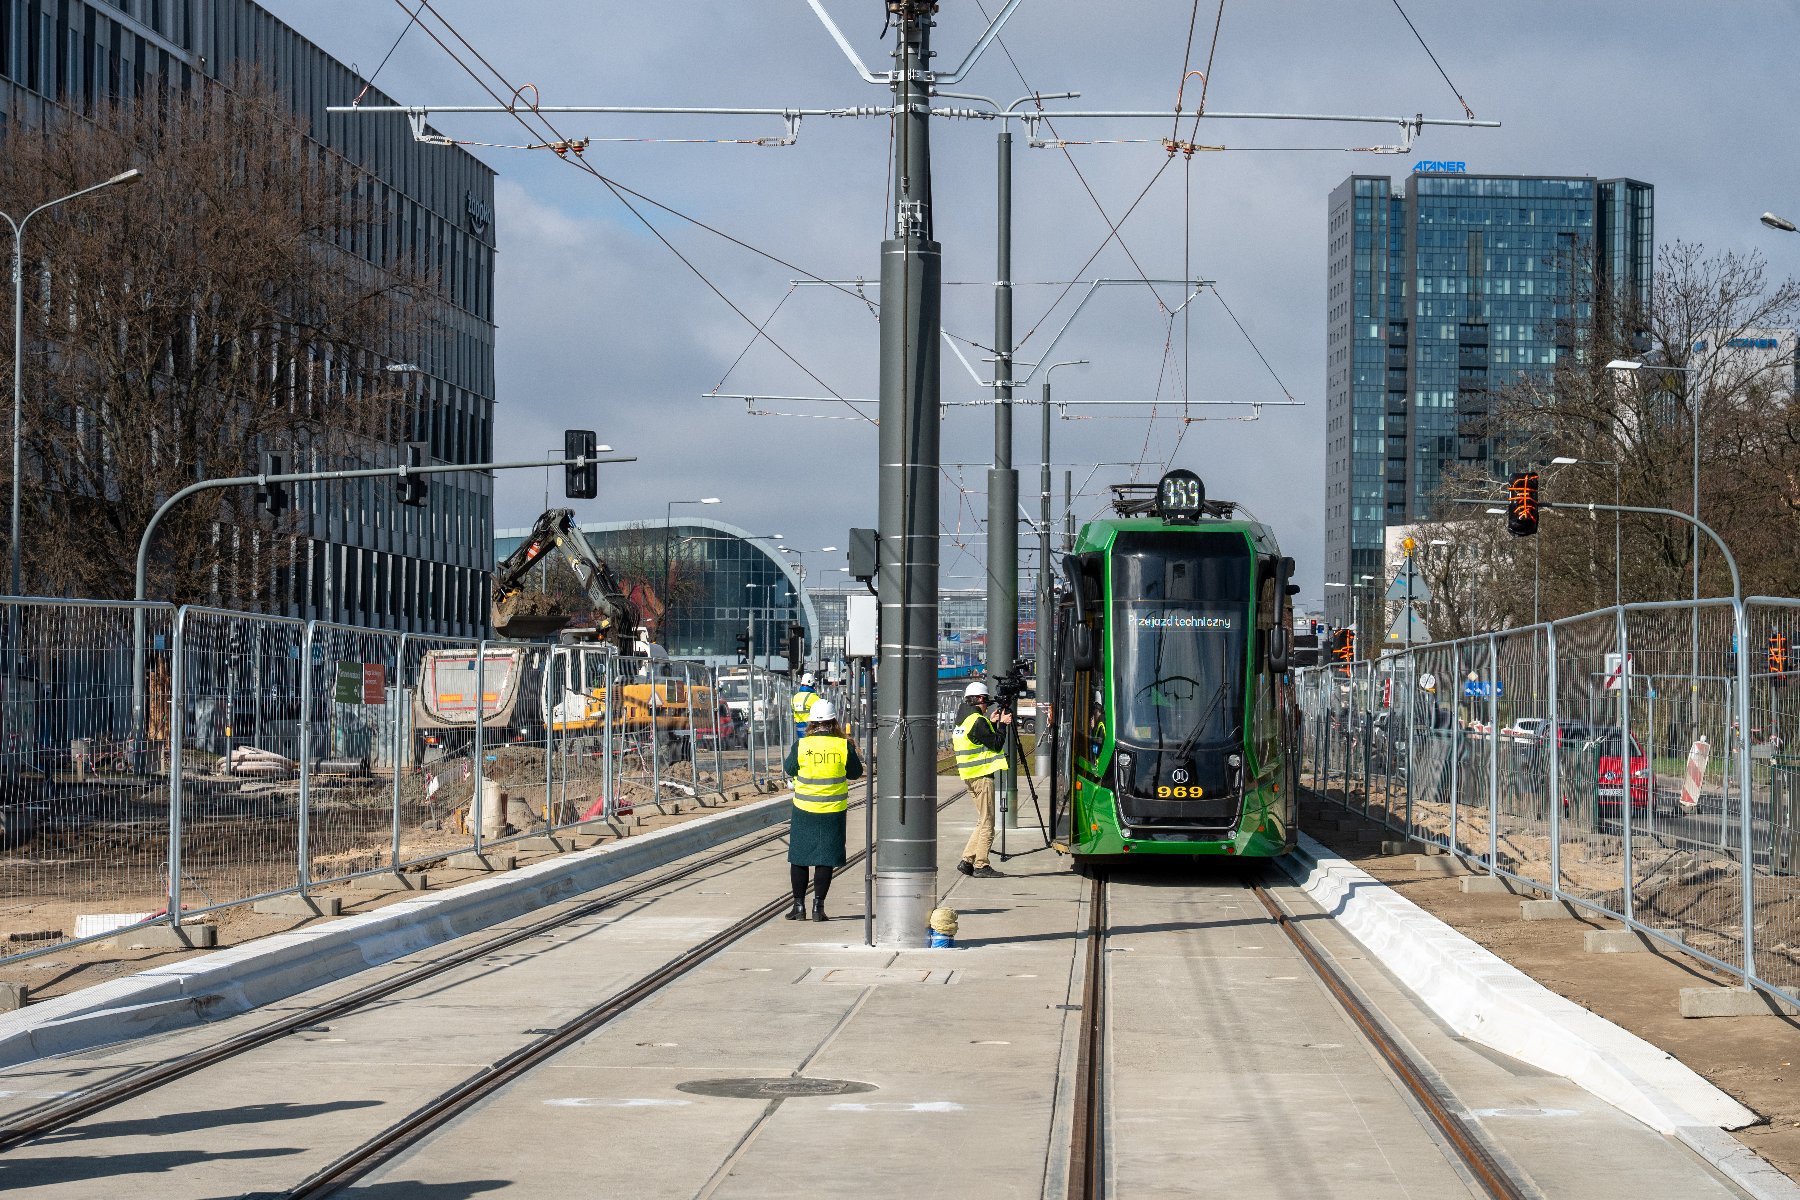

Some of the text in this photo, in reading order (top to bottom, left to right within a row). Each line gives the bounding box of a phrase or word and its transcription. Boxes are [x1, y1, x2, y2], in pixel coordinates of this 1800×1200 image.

[1411, 160, 1466, 172] ATANER
[1128, 614, 1231, 628] Przejazd techniczny
[1157, 785, 1203, 798] 969
